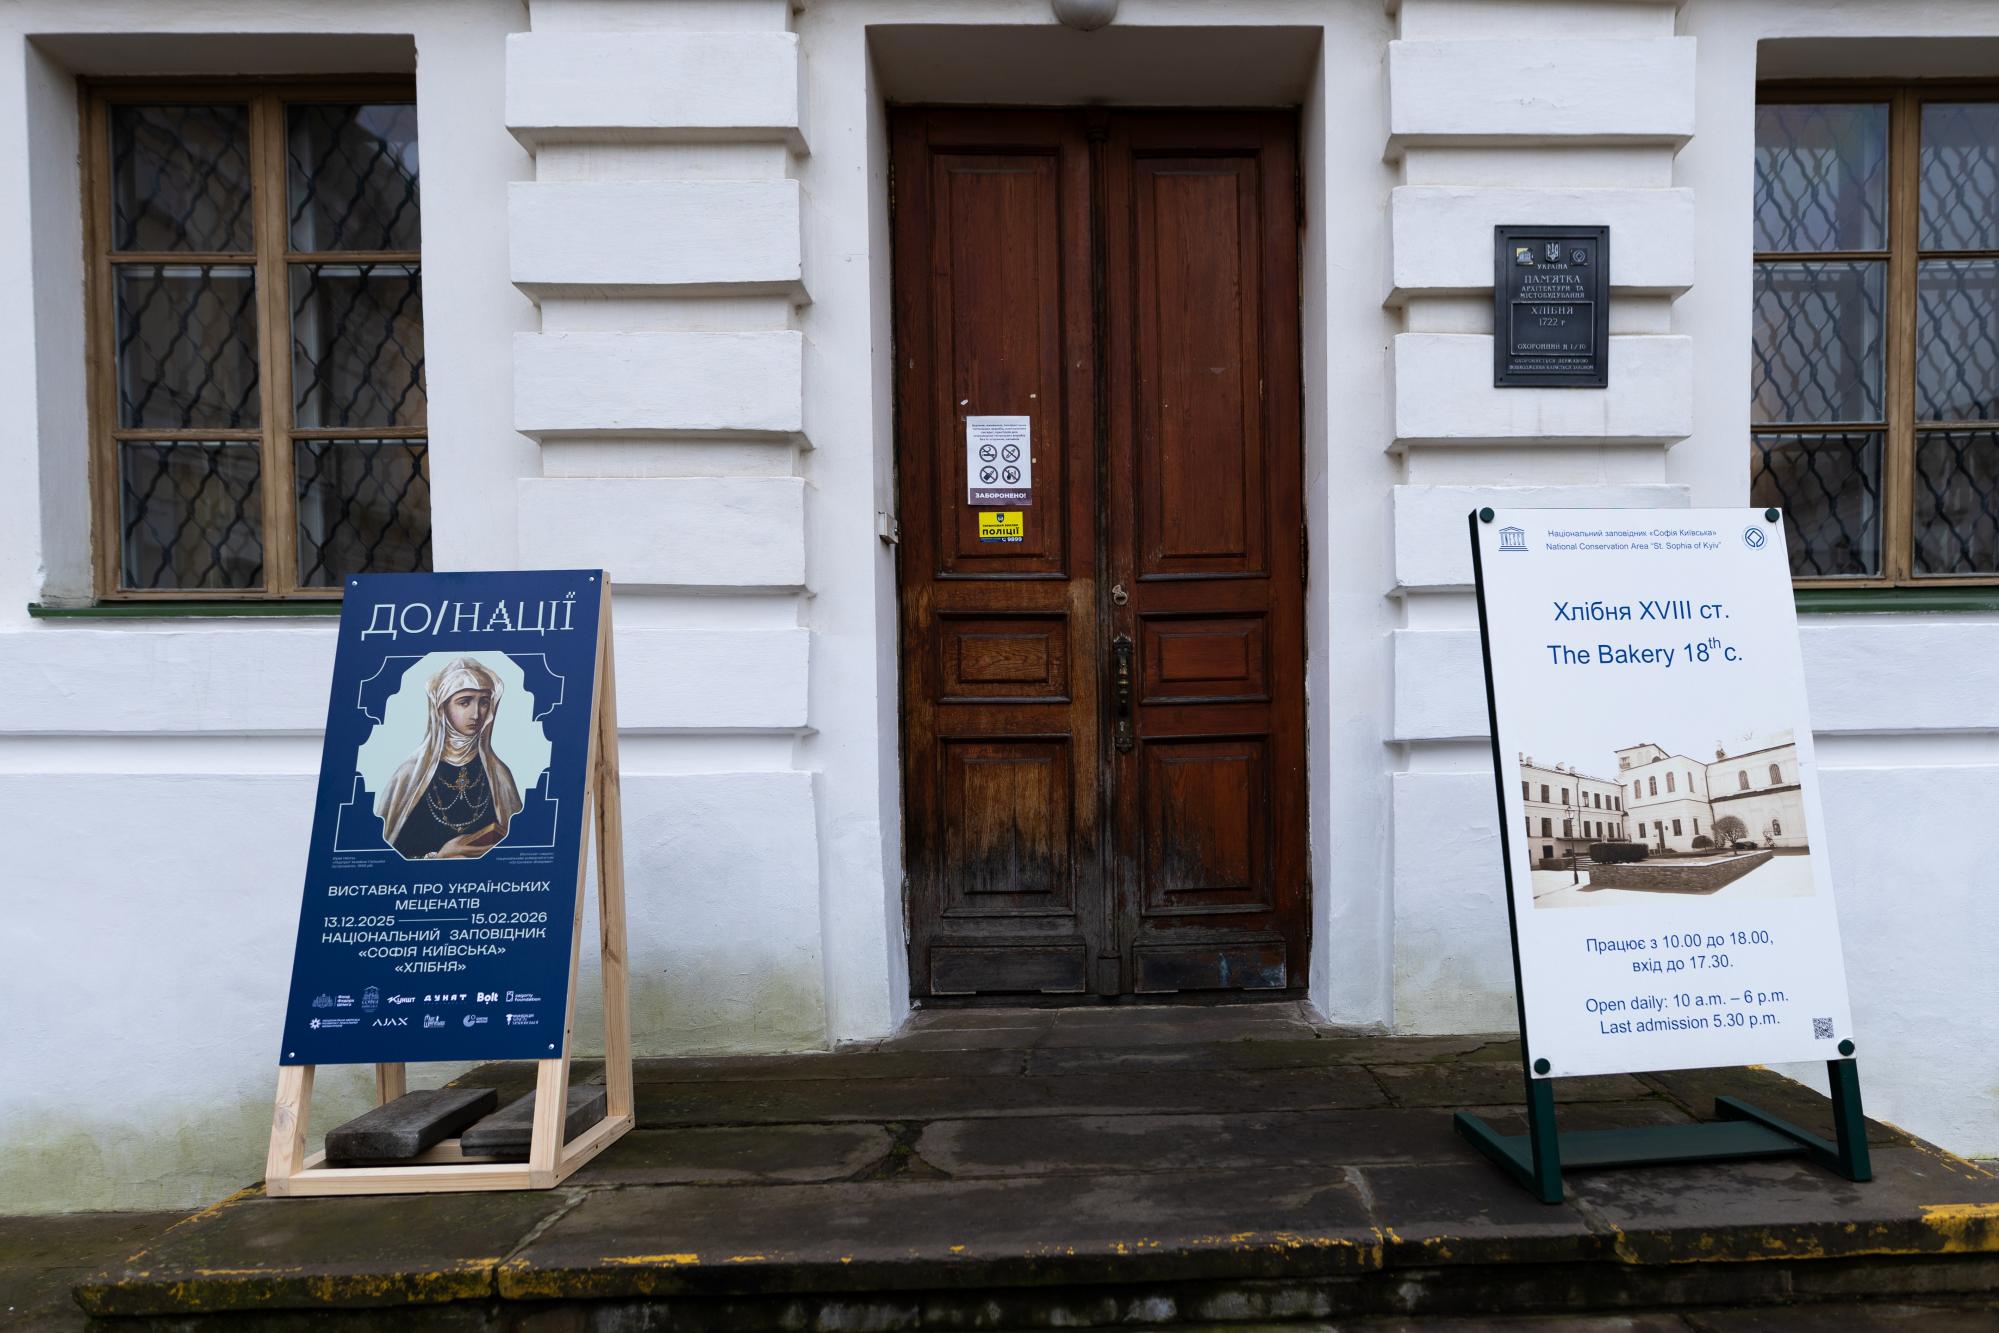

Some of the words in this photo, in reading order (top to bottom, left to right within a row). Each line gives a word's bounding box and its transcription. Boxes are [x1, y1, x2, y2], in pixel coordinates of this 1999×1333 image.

[1531, 307, 1574, 315] ХЛІБНЯ
[1540, 318, 1558, 326] 1722
[982, 527, 1020, 535] ПОЛІЦІЇ
[1548, 530, 1602, 539] Національний
[1605, 530, 1647, 538] заповідник
[1650, 529, 1677, 538] «Софія
[1680, 529, 1717, 537] Київська»
[1546, 542, 1577, 550] National
[1580, 542, 1629, 550] Conservation
[1631, 542, 1649, 550] Area
[1666, 542, 1693, 551] Sophia
[1554, 601, 1632, 621] Хлібня
[1639, 600, 1692, 620] XVIII
[1700, 603, 1730, 619] ст.
[1547, 645, 1590, 665] The
[1599, 644, 1675, 668] Bakery
[1724, 646, 1743, 661] c.
[328, 883, 407, 897] ВИСТАВКА
[413, 883, 443, 895] ПРО
[449, 880, 551, 894] УКРАЇНСЬКИХ
[395, 898, 480, 912] МЕЦЕНАТІВ
[324, 915, 395, 928] 13.12.2025
[471, 912, 548, 924] 15.02.2026
[322, 928, 440, 945] НАЦІОНАЛЬНИЙ
[450, 927, 546, 941] ЗАПОВІДНИК
[1586, 938, 1646, 954] Працює
[1650, 939, 1657, 949] з
[1663, 934, 1701, 949] 10.00
[1706, 935, 1725, 949] до
[1730, 930, 1774, 946] 18.00,
[359, 946, 417, 959] «СОФІЯ
[422, 944, 506, 957] КИЇВСЬКА»
[394, 962, 466, 974] «ХЛІБНЯ»
[1632, 958, 1662, 974] вхід
[1666, 958, 1685, 973] до
[1690, 954, 1734, 969] 17.30.
[477, 992, 499, 1004] Bolt
[1586, 998, 1626, 1015] Open
[1631, 996, 1668, 1012] daily:
[1673, 993, 1690, 1008] 10
[1695, 994, 1726, 1007] a.m.
[1744, 990, 1753, 1004] 6
[1758, 992, 1789, 1007] p.m.
[372, 1017, 408, 1027] AJAX
[1600, 1020, 1631, 1035] Last
[1636, 1016, 1709, 1032] admission
[1713, 1012, 1744, 1028] 5.30
[1749, 1013, 1780, 1029] p.m.
